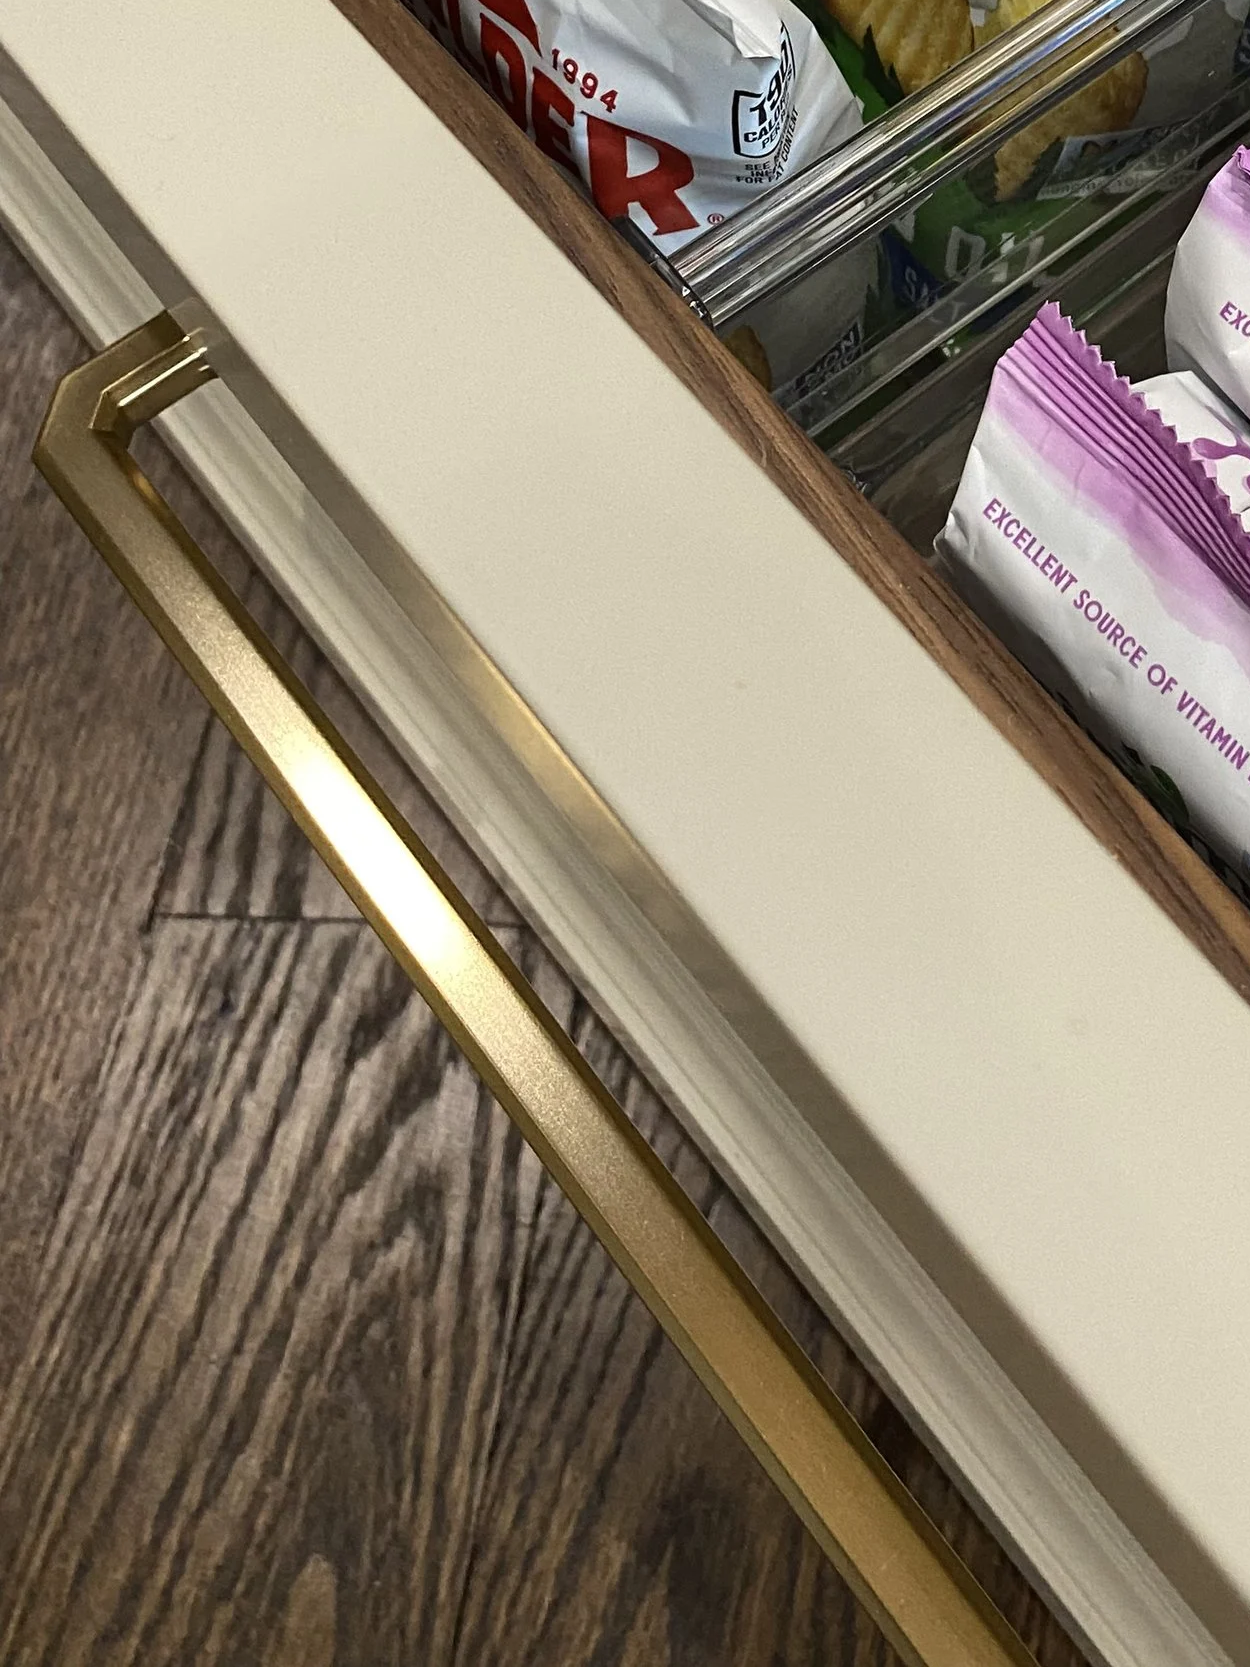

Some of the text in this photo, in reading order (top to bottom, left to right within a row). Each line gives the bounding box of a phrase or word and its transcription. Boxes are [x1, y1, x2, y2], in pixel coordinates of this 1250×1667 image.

[550, 48, 618, 114] 1994
[982, 497, 1078, 594] EXCELLENT
[1073, 589, 1148, 669] SOURCE
[1147, 663, 1179, 696] OF
